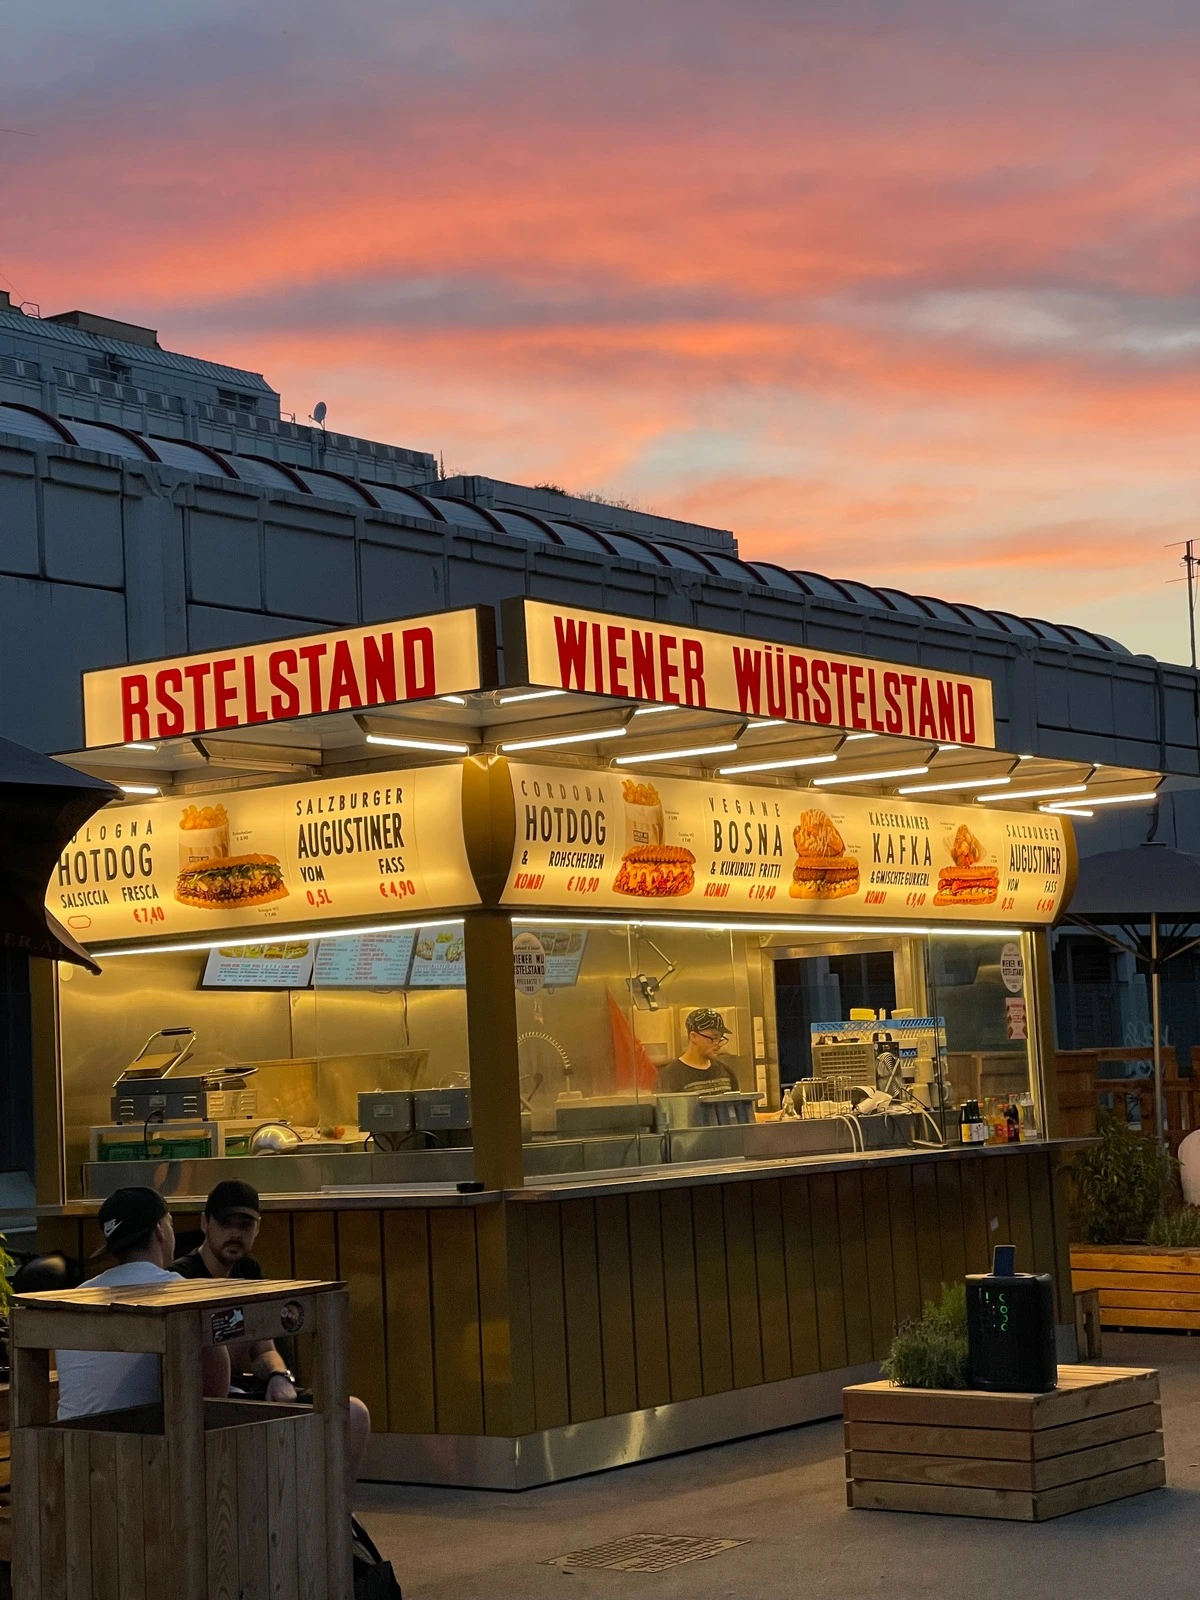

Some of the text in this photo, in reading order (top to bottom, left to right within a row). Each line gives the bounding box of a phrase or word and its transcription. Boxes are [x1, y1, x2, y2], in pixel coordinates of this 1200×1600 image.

[121, 626, 436, 742] RSTELSTAND
[554, 616, 976, 744] WIENER WÜRSTELSTAND
[296, 788, 403, 816] SALZBURGER
[521, 780, 605, 803] CORDOBA
[708, 797, 780, 818] VEGANE
[525, 804, 606, 846] HOTDOG
[869, 811, 930, 830] KAESEKRAINER
[298, 812, 405, 859] AUGUSTINER
[713, 819, 783, 857] BOSNA
[1006, 824, 1060, 841] SALZBURGER
[521, 850, 605, 869] & ROHSCHEIBEN
[872, 832, 932, 867] KAFKA
[1009, 843, 1061, 875] AUGUSTINER
[57, 843, 153, 887] HOTDOG
[300, 856, 406, 882] VOM FASS
[710, 860, 781, 879] & KUKURUZI FRITTI
[513, 873, 546, 890] KOMBI
[870, 870, 876, 884] &
[1006, 878, 1058, 893] VOM FASS
[60, 884, 160, 909] SALSICCIA FRESCA
[306, 888, 333, 908] 0,5L
[703, 882, 731, 898] KOMBI
[863, 890, 887, 905] KOMBI
